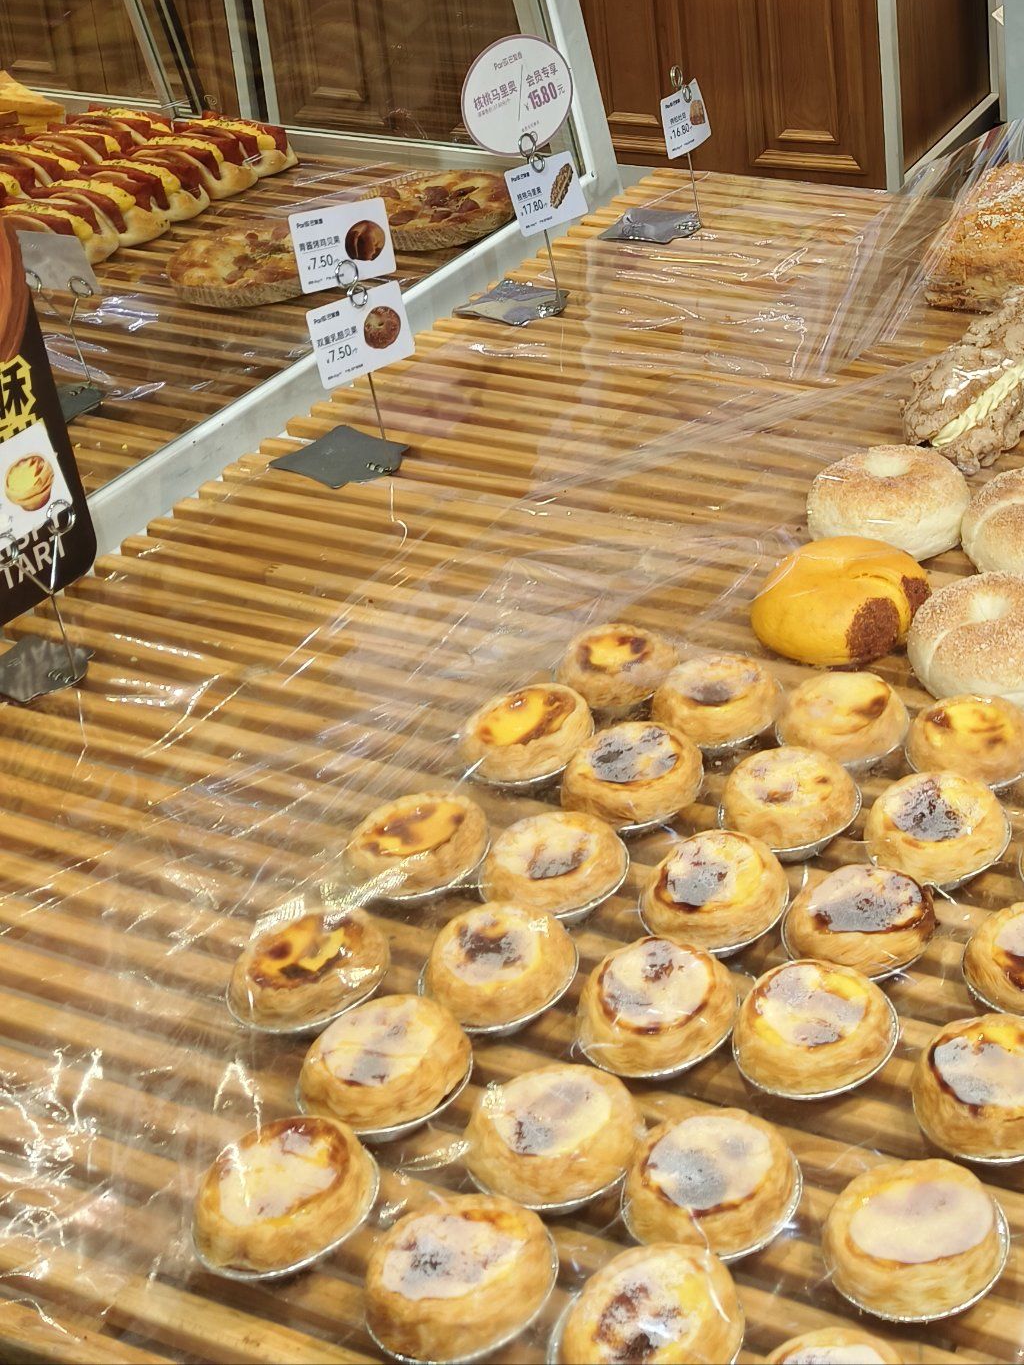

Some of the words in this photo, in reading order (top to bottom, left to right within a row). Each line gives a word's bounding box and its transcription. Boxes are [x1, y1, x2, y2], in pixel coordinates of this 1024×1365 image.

[526, 62, 558, 87] 会员专享
[474, 80, 517, 111] 核桃马里奥
